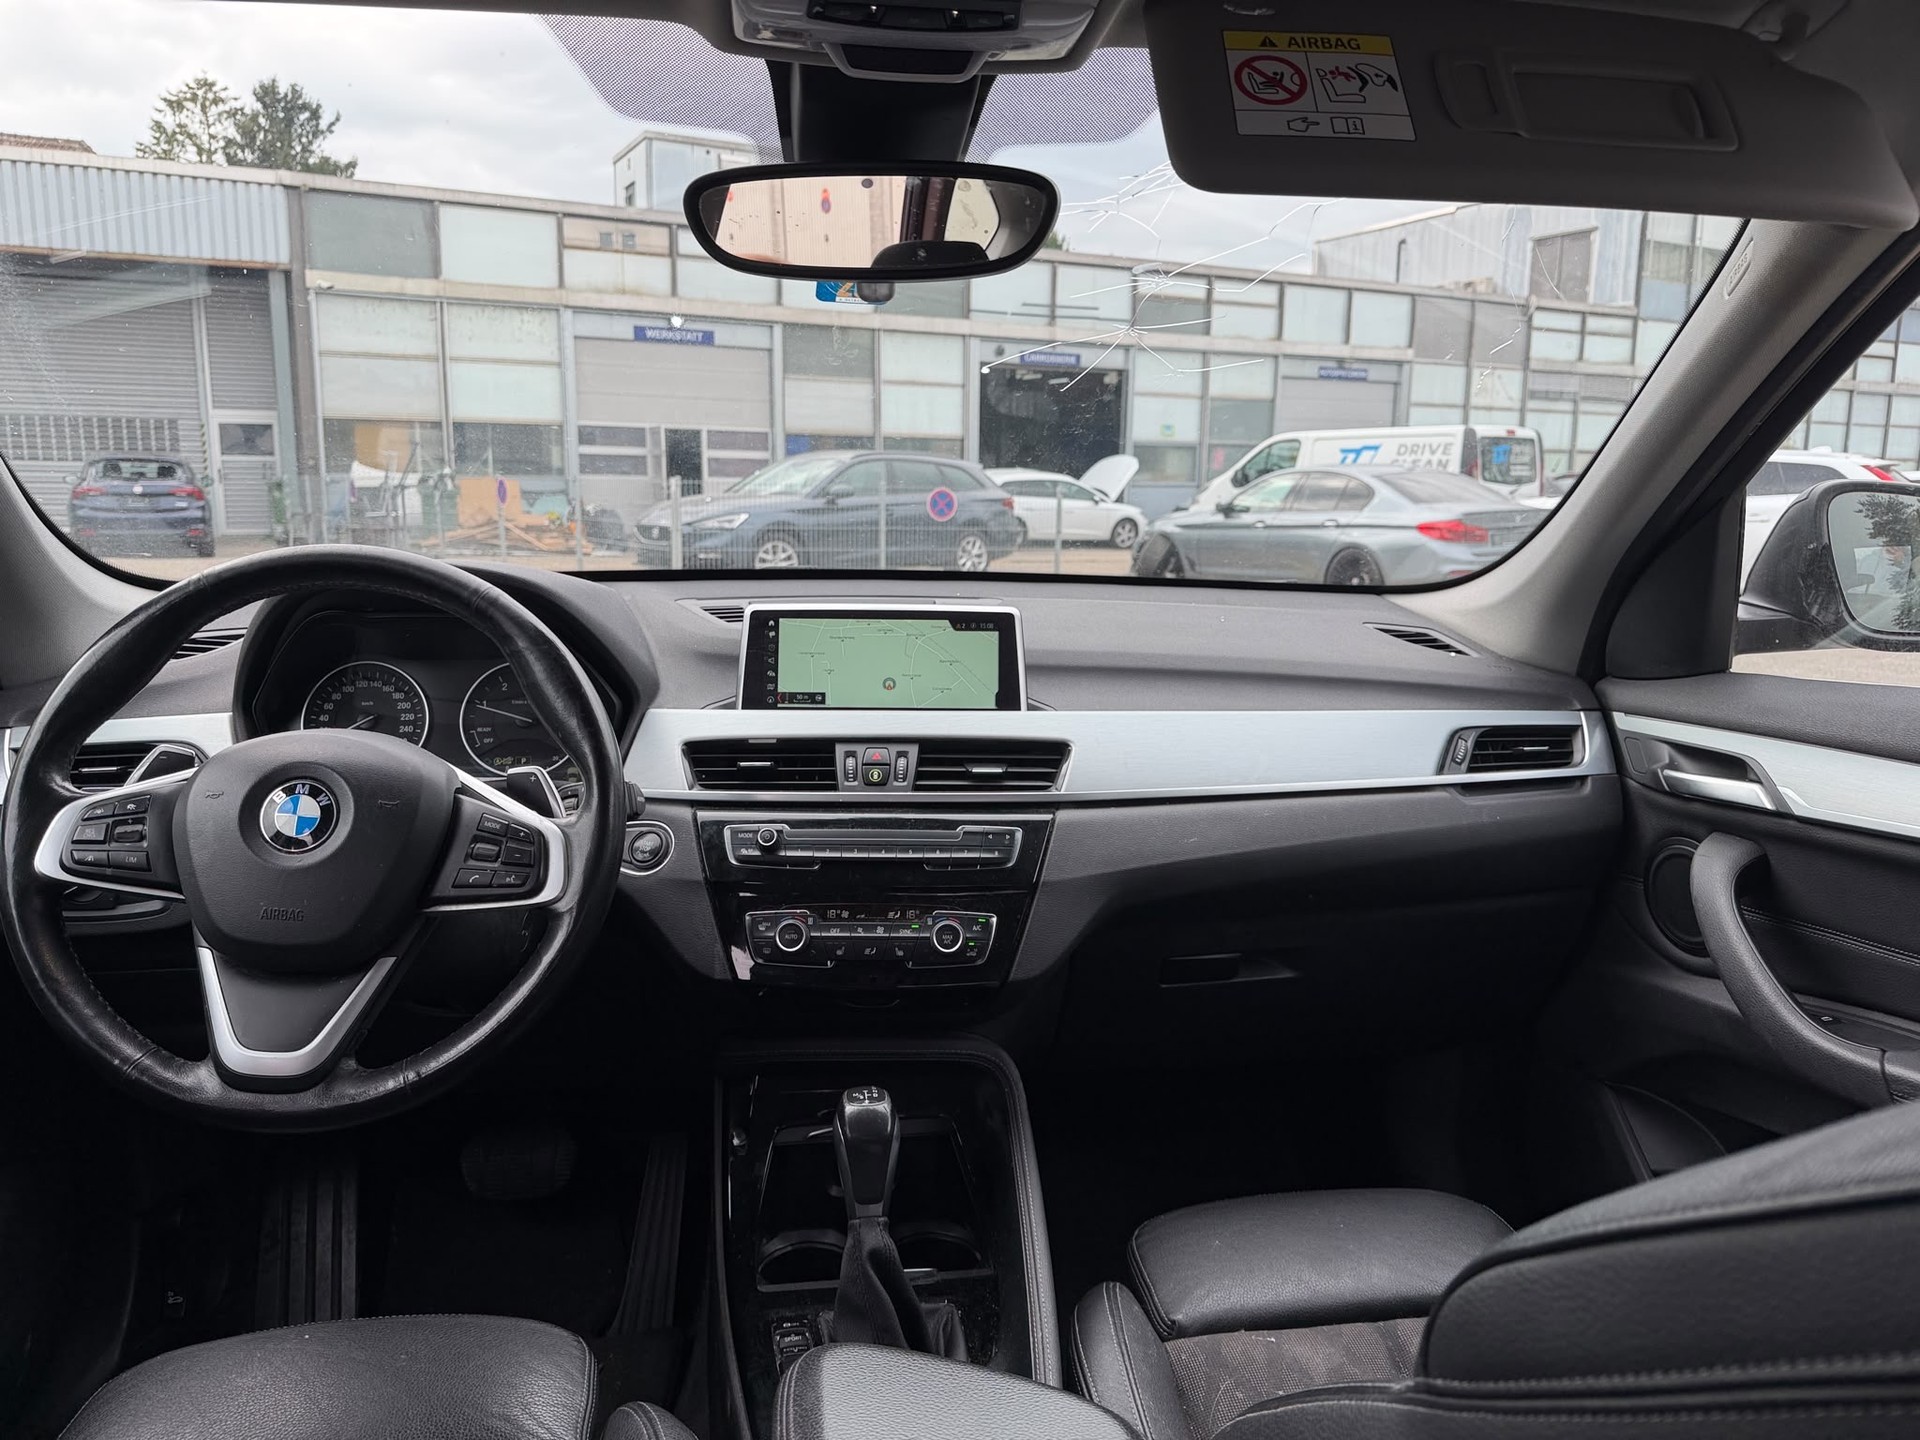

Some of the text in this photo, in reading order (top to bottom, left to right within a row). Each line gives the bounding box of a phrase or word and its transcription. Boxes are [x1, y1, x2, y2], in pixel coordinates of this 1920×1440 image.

[1287, 36, 1361, 50] AIRBAG
[645, 327, 704, 343] WERKSTATT
[1396, 442, 1455, 457] DRIVE
[502, 683, 508, 691] 2
[397, 702, 411, 710] 200
[521, 757, 527, 765] P
[272, 783, 331, 807] BMW
[484, 820, 501, 830] MODE
[260, 907, 305, 922] AIRBAG
